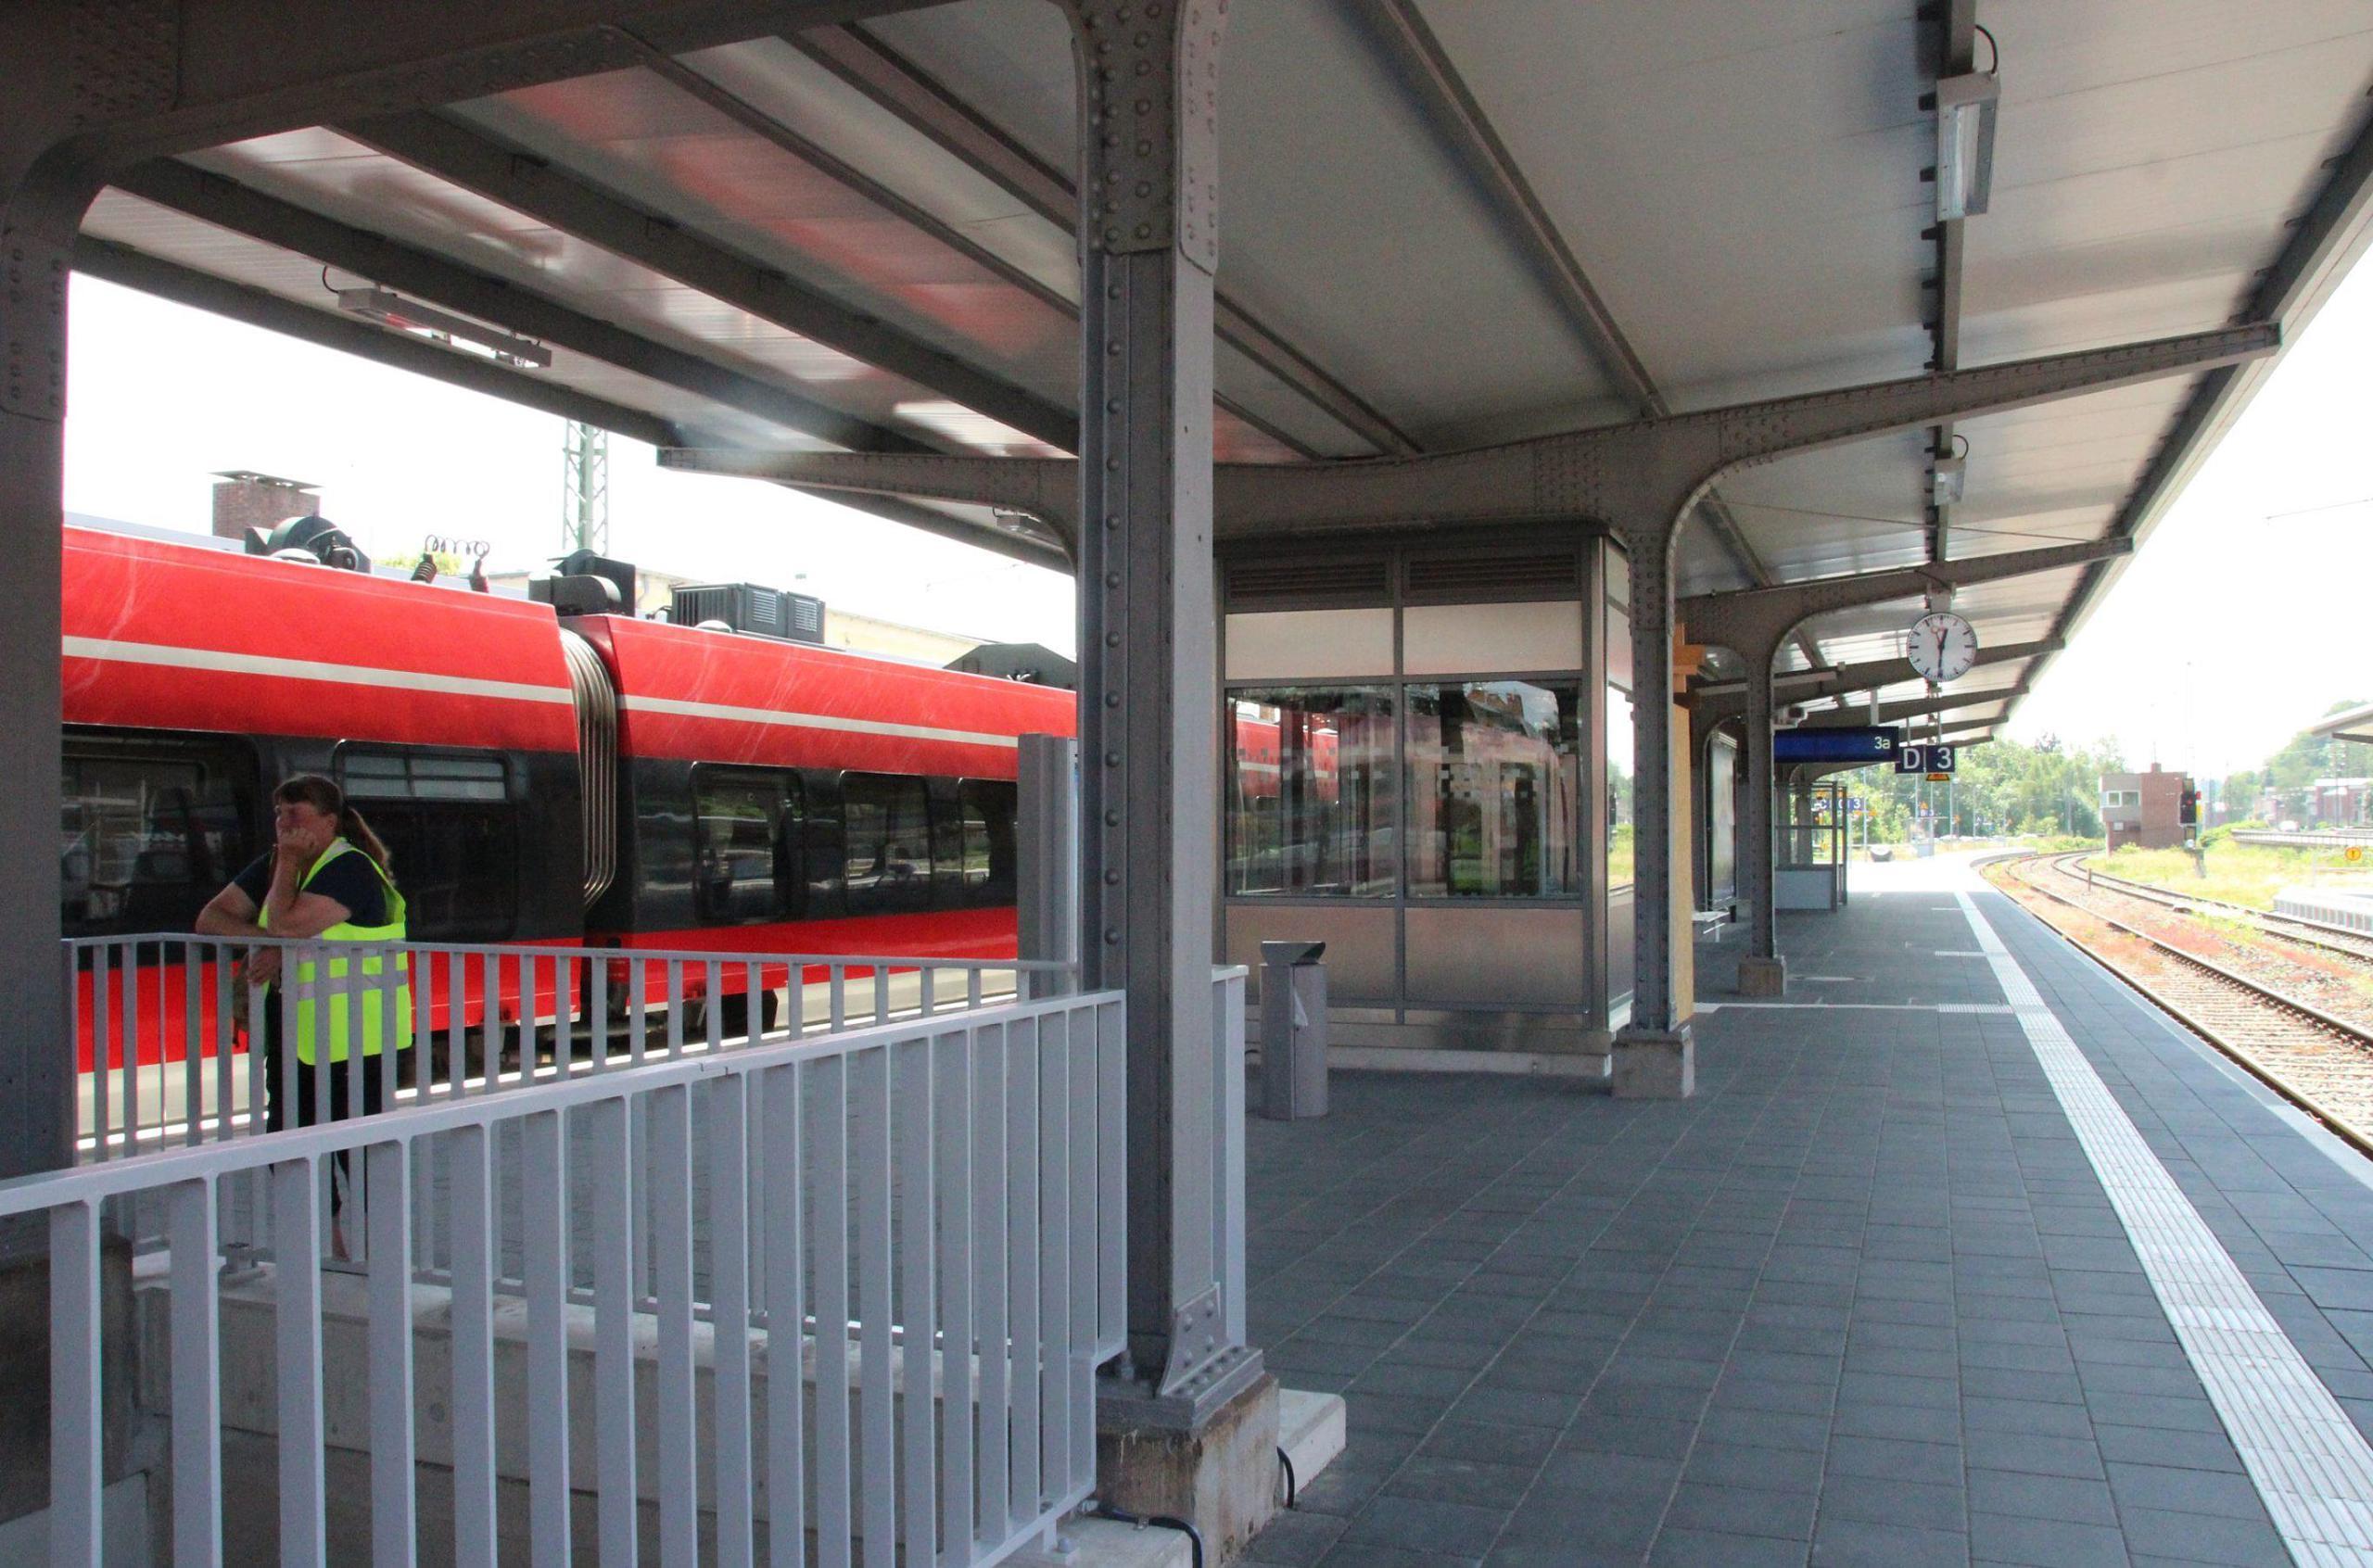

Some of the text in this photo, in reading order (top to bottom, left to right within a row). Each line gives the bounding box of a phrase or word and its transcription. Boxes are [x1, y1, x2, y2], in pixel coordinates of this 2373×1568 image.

[1874, 737, 1890, 750] 3a
[1903, 747, 1951, 769] D 3
[1854, 798, 1861, 809] 3
